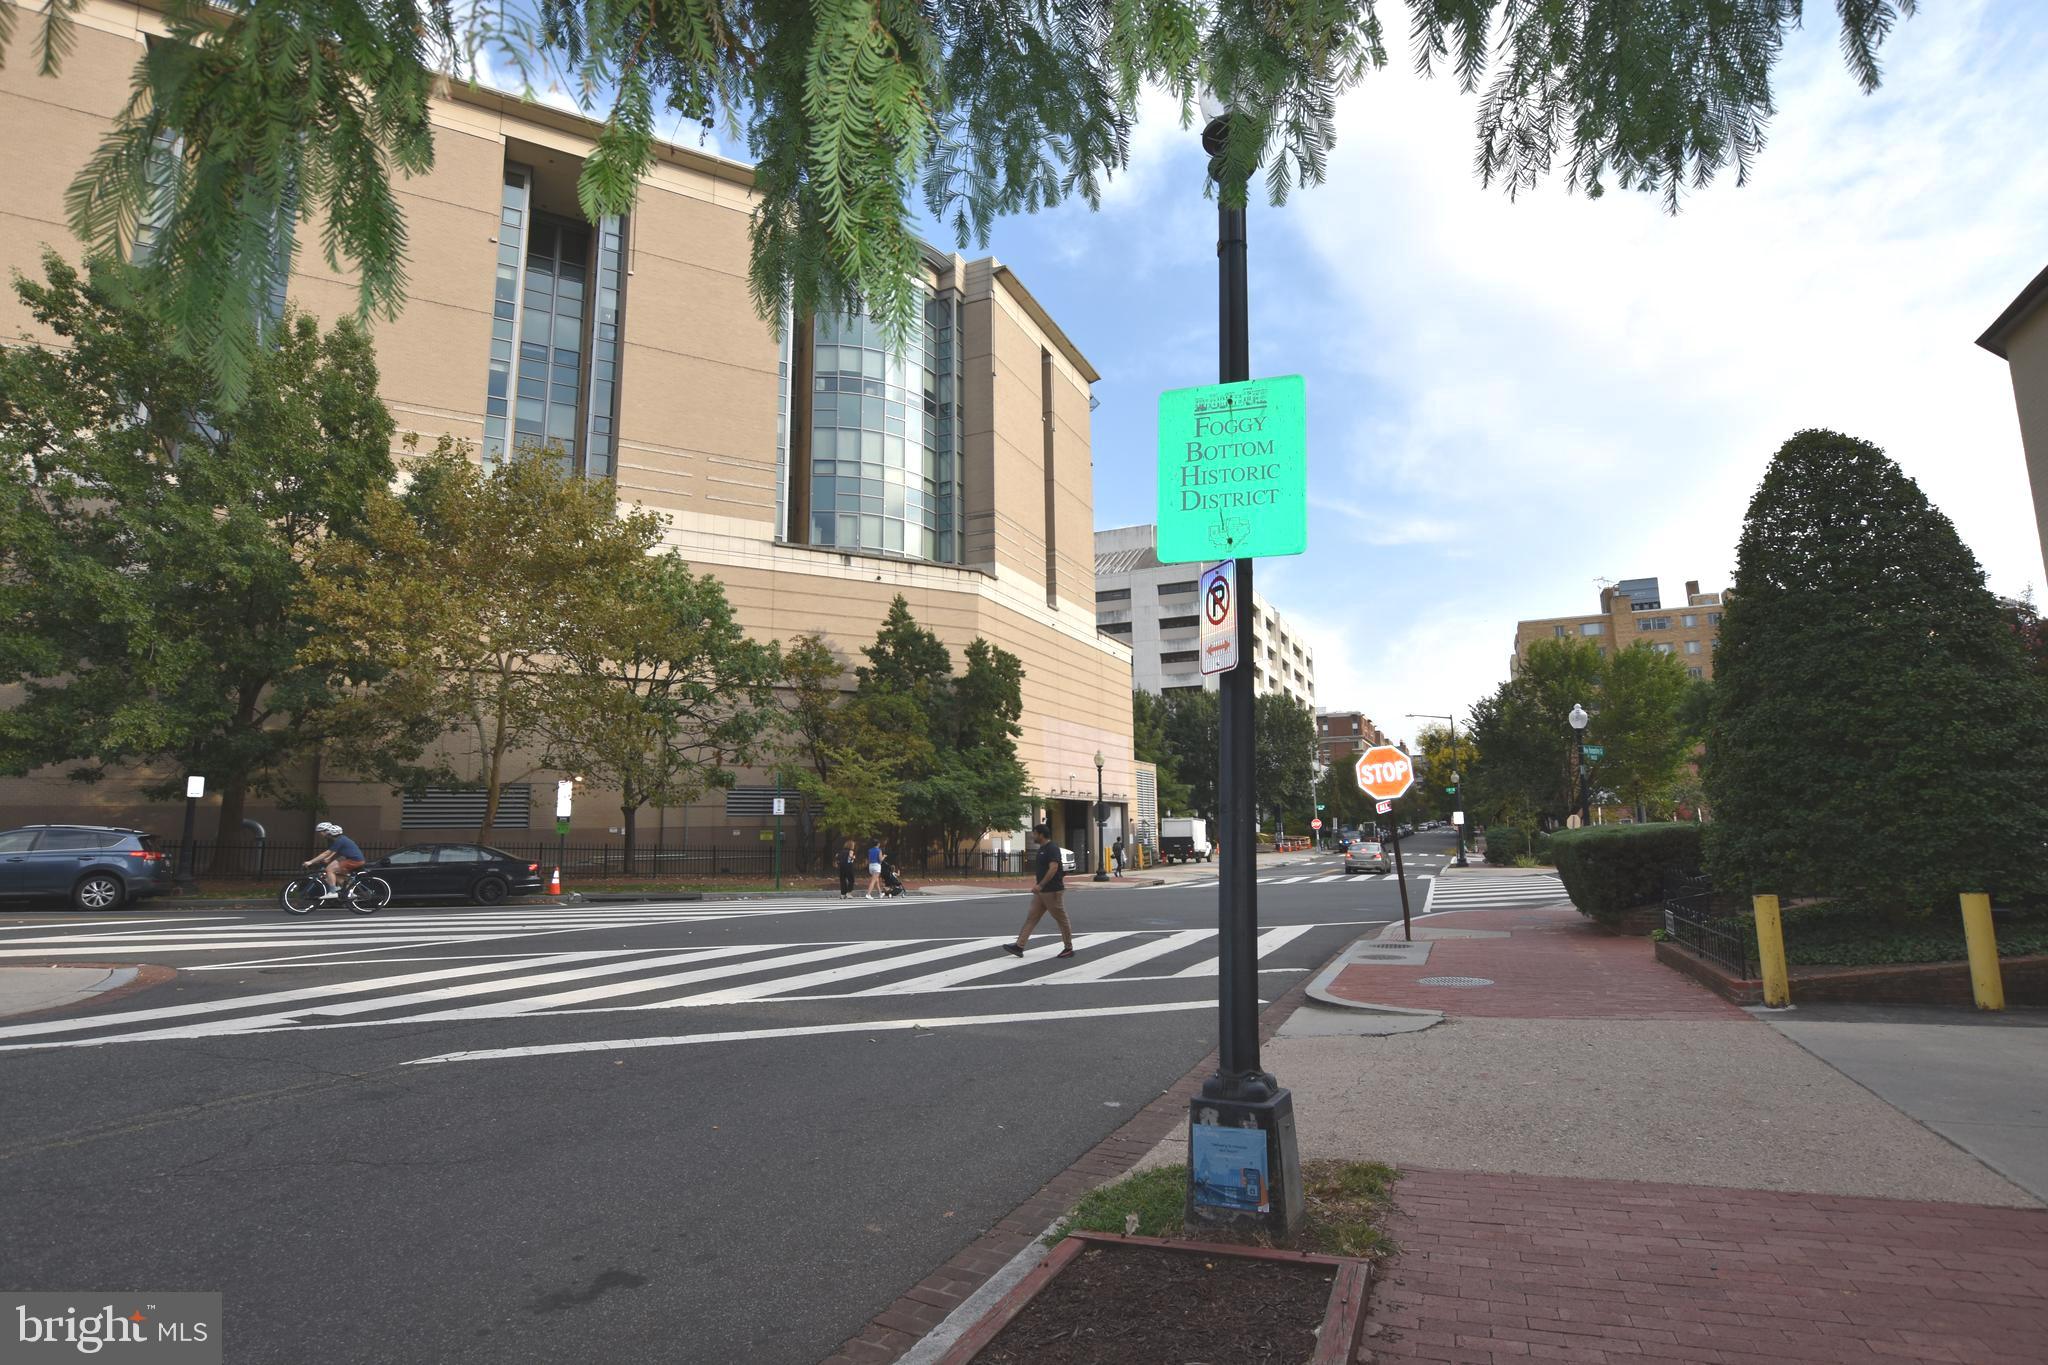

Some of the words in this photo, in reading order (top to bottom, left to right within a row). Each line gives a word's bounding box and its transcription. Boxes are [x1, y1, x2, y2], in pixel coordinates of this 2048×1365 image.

[1194, 416, 1267, 438] FOGGY
[1185, 440, 1274, 462] BOTTOM
[1180, 464, 1281, 487] HISTORIC
[1180, 489, 1280, 511] DISTRICT
[1361, 761, 1408, 784] STOP
